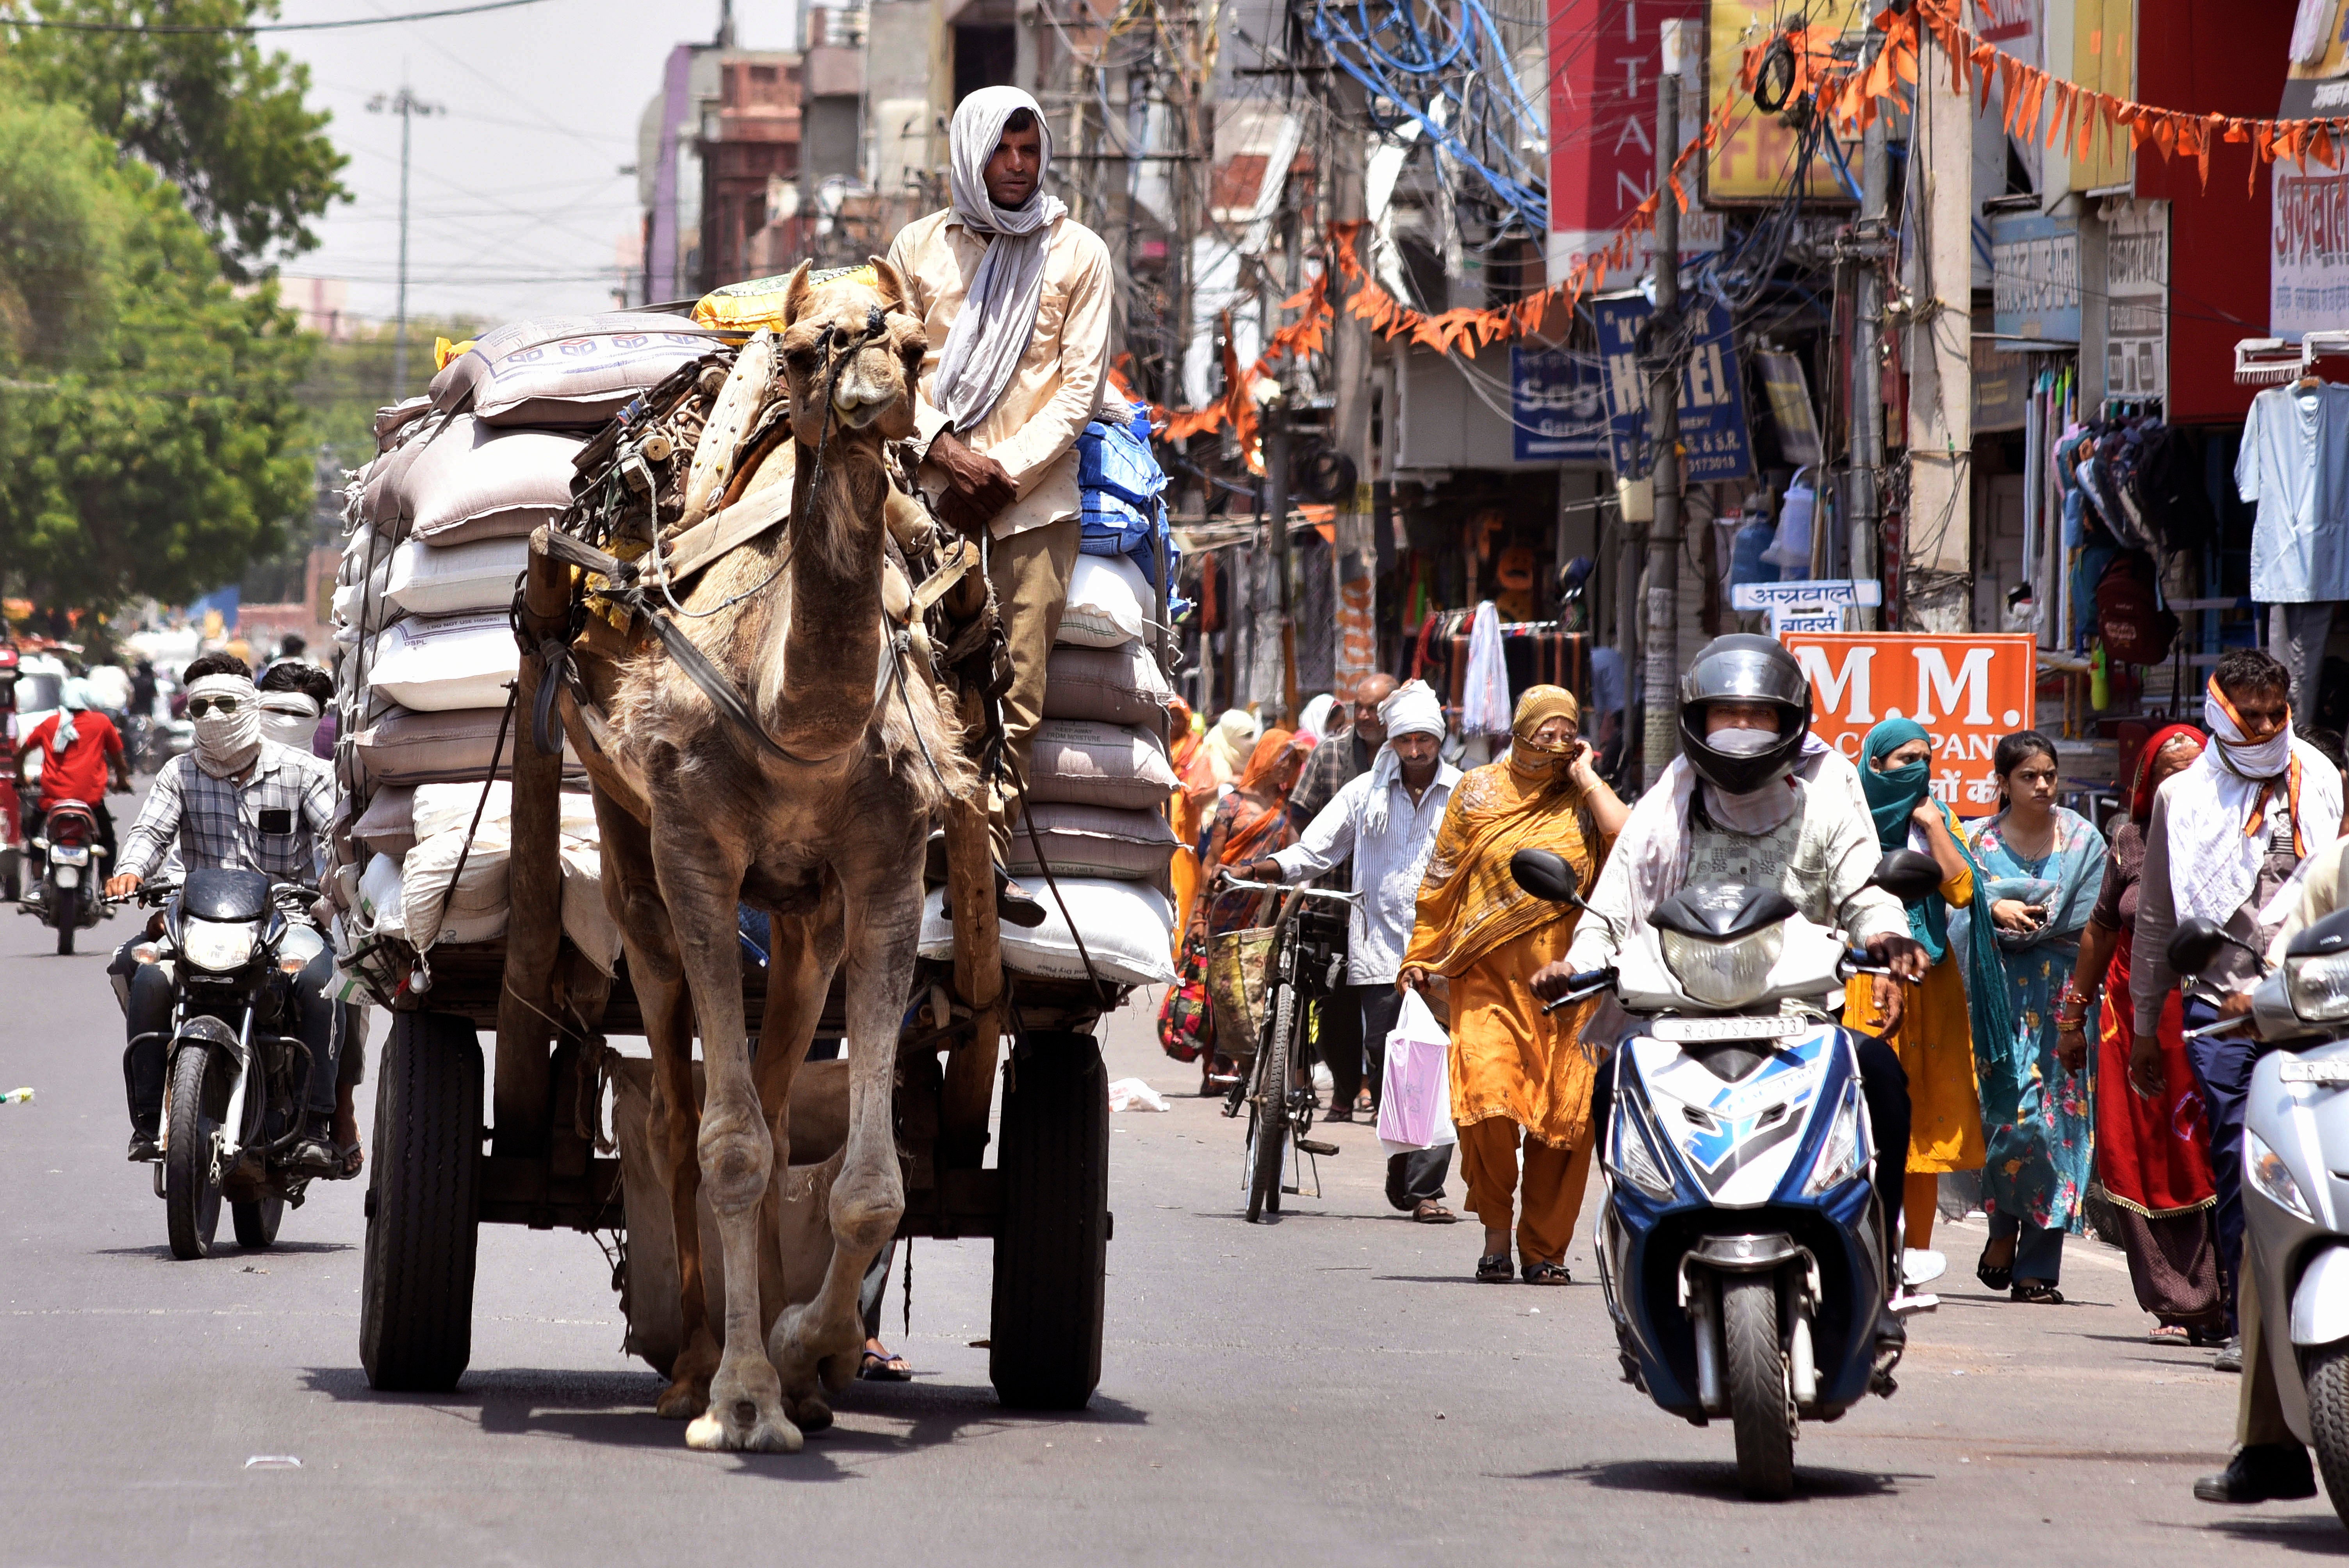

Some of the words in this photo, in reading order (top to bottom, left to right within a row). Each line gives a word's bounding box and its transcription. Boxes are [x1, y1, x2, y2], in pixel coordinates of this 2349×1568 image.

[1748, 586, 1852, 604] अग्रवाल
[1067, 734, 1101, 742] MOISTURE
[1037, 964, 1057, 973] Place
